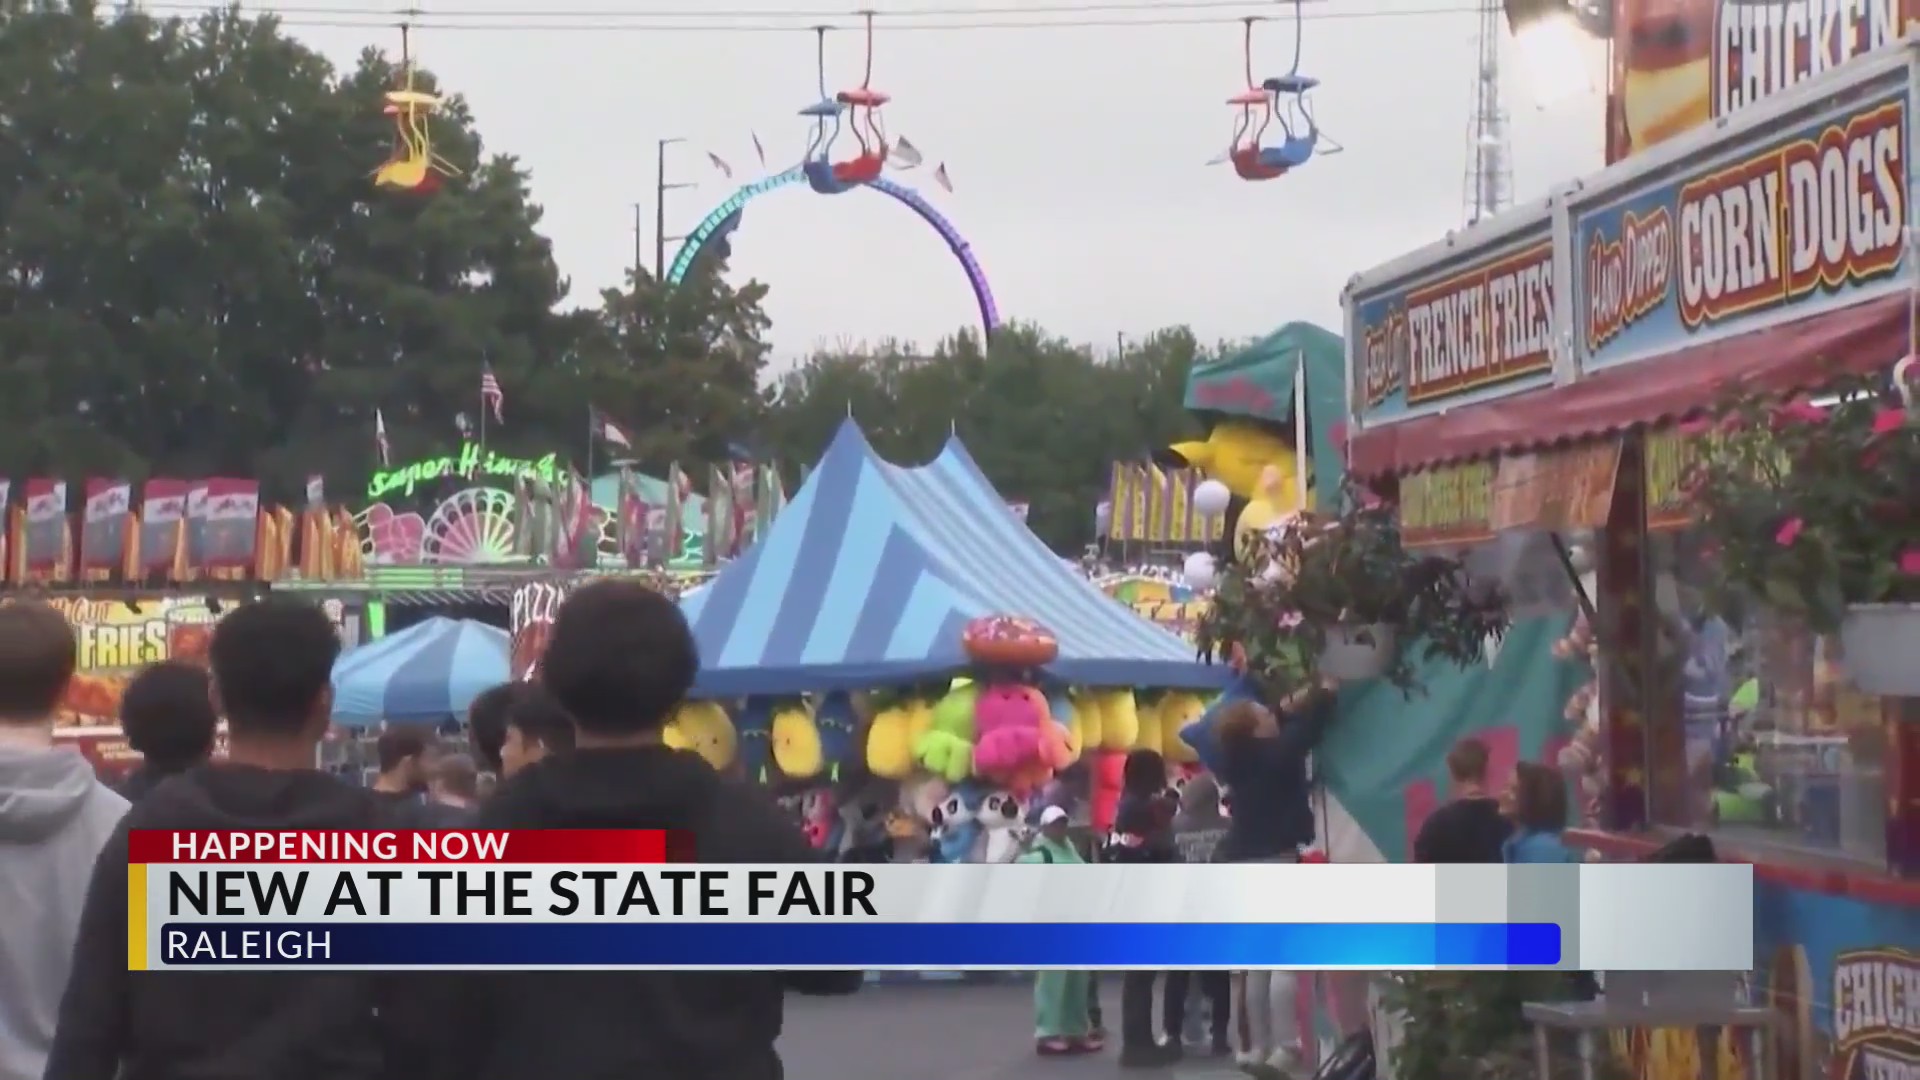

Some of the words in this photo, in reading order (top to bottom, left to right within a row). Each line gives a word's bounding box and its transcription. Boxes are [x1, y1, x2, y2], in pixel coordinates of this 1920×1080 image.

[1681, 171, 1780, 307] CORN
[1790, 126, 1901, 272] DOGS
[1408, 284, 1487, 388] FRENCH
[1490, 257, 1555, 364] FRIES
[80, 620, 167, 669] FRIES
